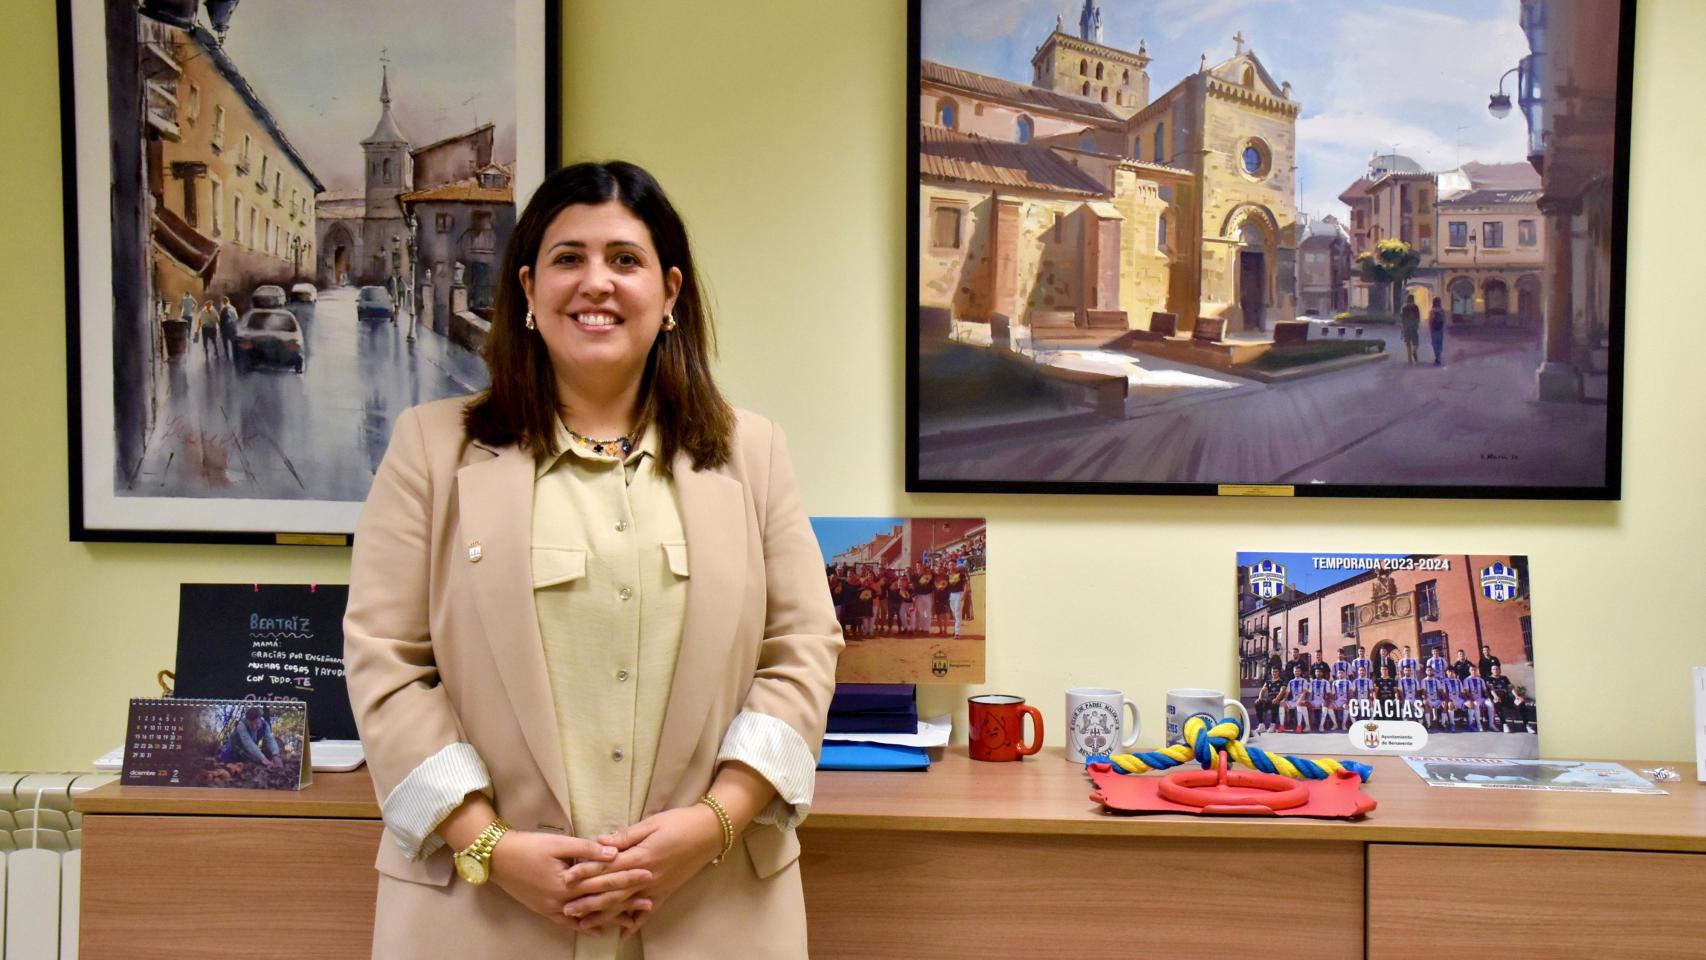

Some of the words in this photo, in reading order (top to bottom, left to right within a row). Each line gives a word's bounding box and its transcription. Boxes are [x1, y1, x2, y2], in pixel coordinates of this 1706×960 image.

[1312, 557, 1381, 570] TEMPORADA
[1384, 559, 1451, 571] 2023-2024
[246, 674, 265, 683] CON
[294, 676, 311, 687] TE
[1348, 698, 1425, 719] GRACIAS
